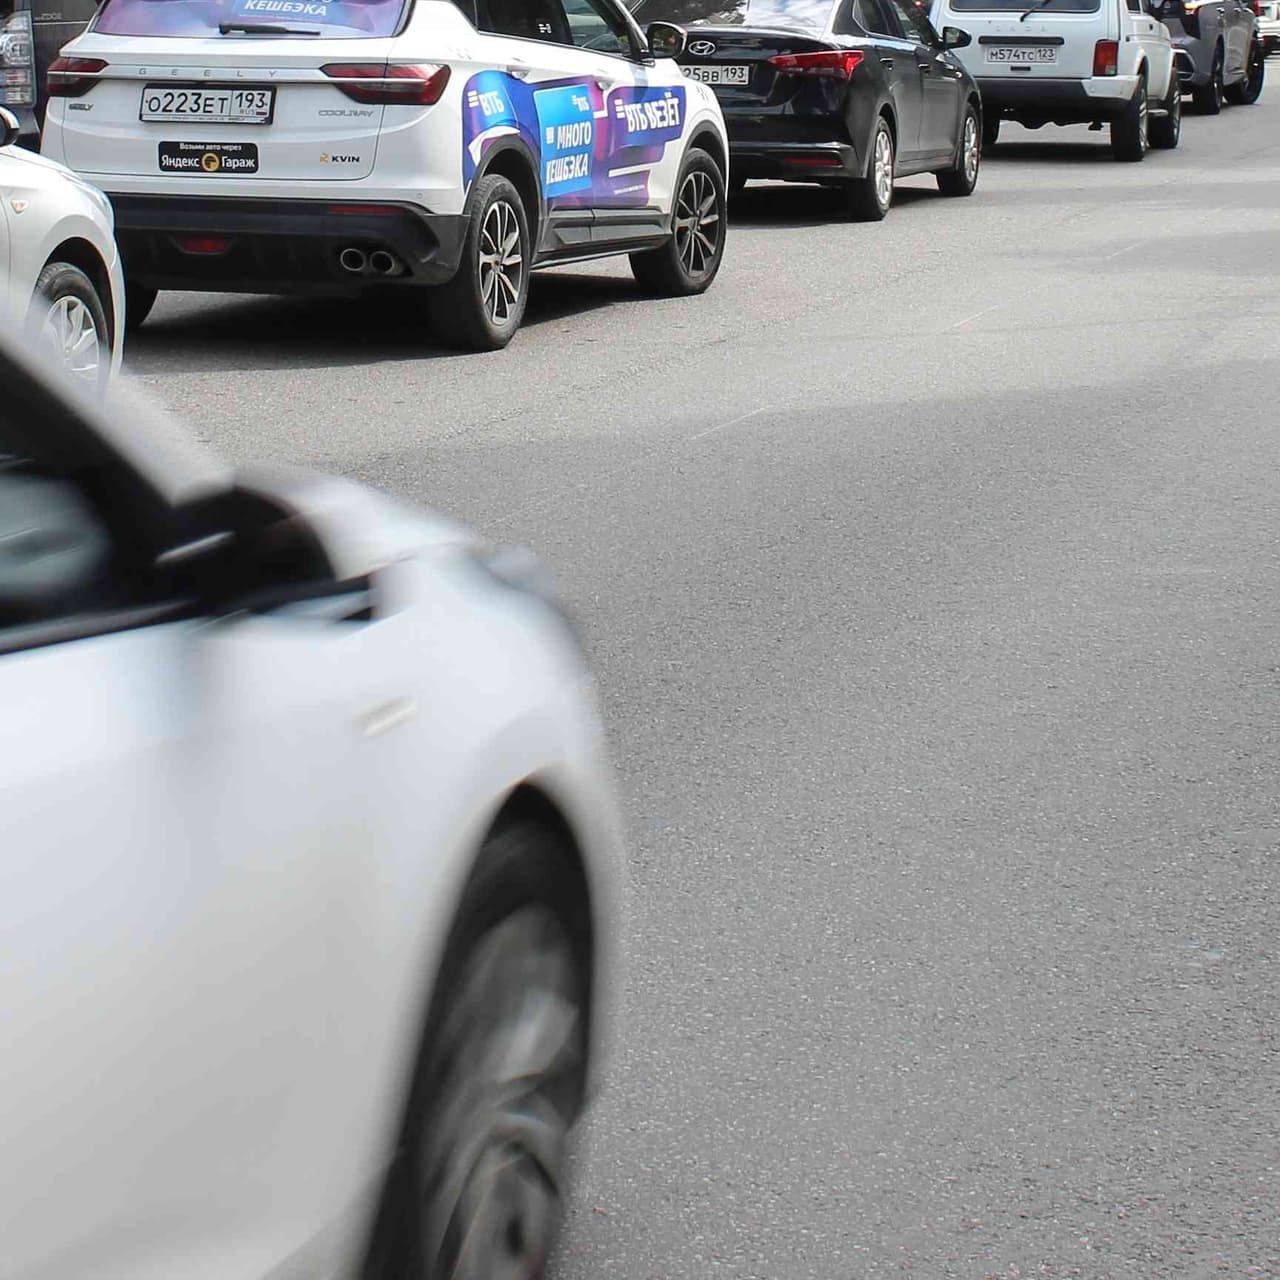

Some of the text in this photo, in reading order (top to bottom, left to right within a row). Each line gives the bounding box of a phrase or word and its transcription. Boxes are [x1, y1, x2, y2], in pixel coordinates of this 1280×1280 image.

[243, 0, 328, 17] КЕШБЭКА
[1038, 48, 1054, 58] 123
[138, 67, 278, 78] GEELY
[683, 67, 745, 82] 25ВВ 193
[148, 92, 266, 113] О223ЕТ 193
[478, 91, 505, 116] ВТБ
[624, 103, 647, 133] ВТБ
[557, 121, 592, 150] МНОГО
[161, 155, 255, 169] Яндекс Гараж
